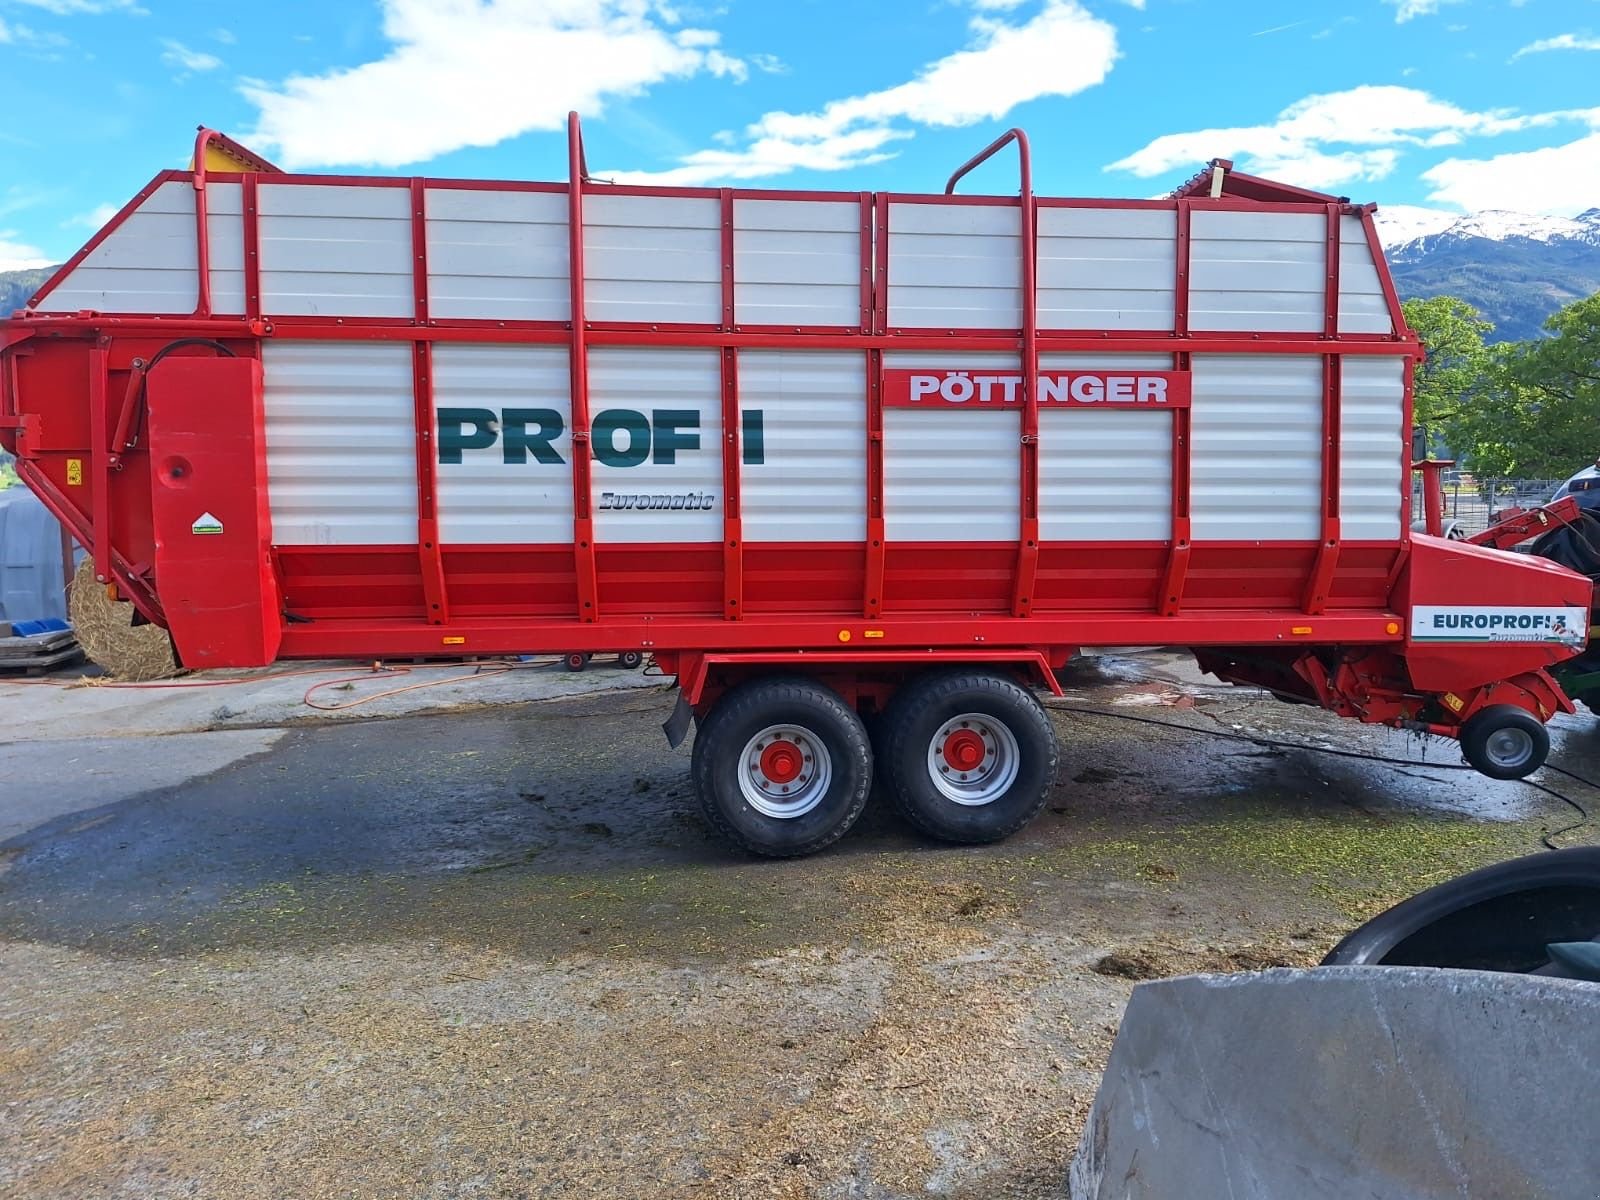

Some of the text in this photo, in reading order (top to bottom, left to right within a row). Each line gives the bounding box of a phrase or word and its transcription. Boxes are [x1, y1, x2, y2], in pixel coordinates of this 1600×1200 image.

[910, 372, 1168, 402] PÖTTNGER
[437, 407, 765, 467] PROFI
[599, 492, 714, 510] Euromatic
